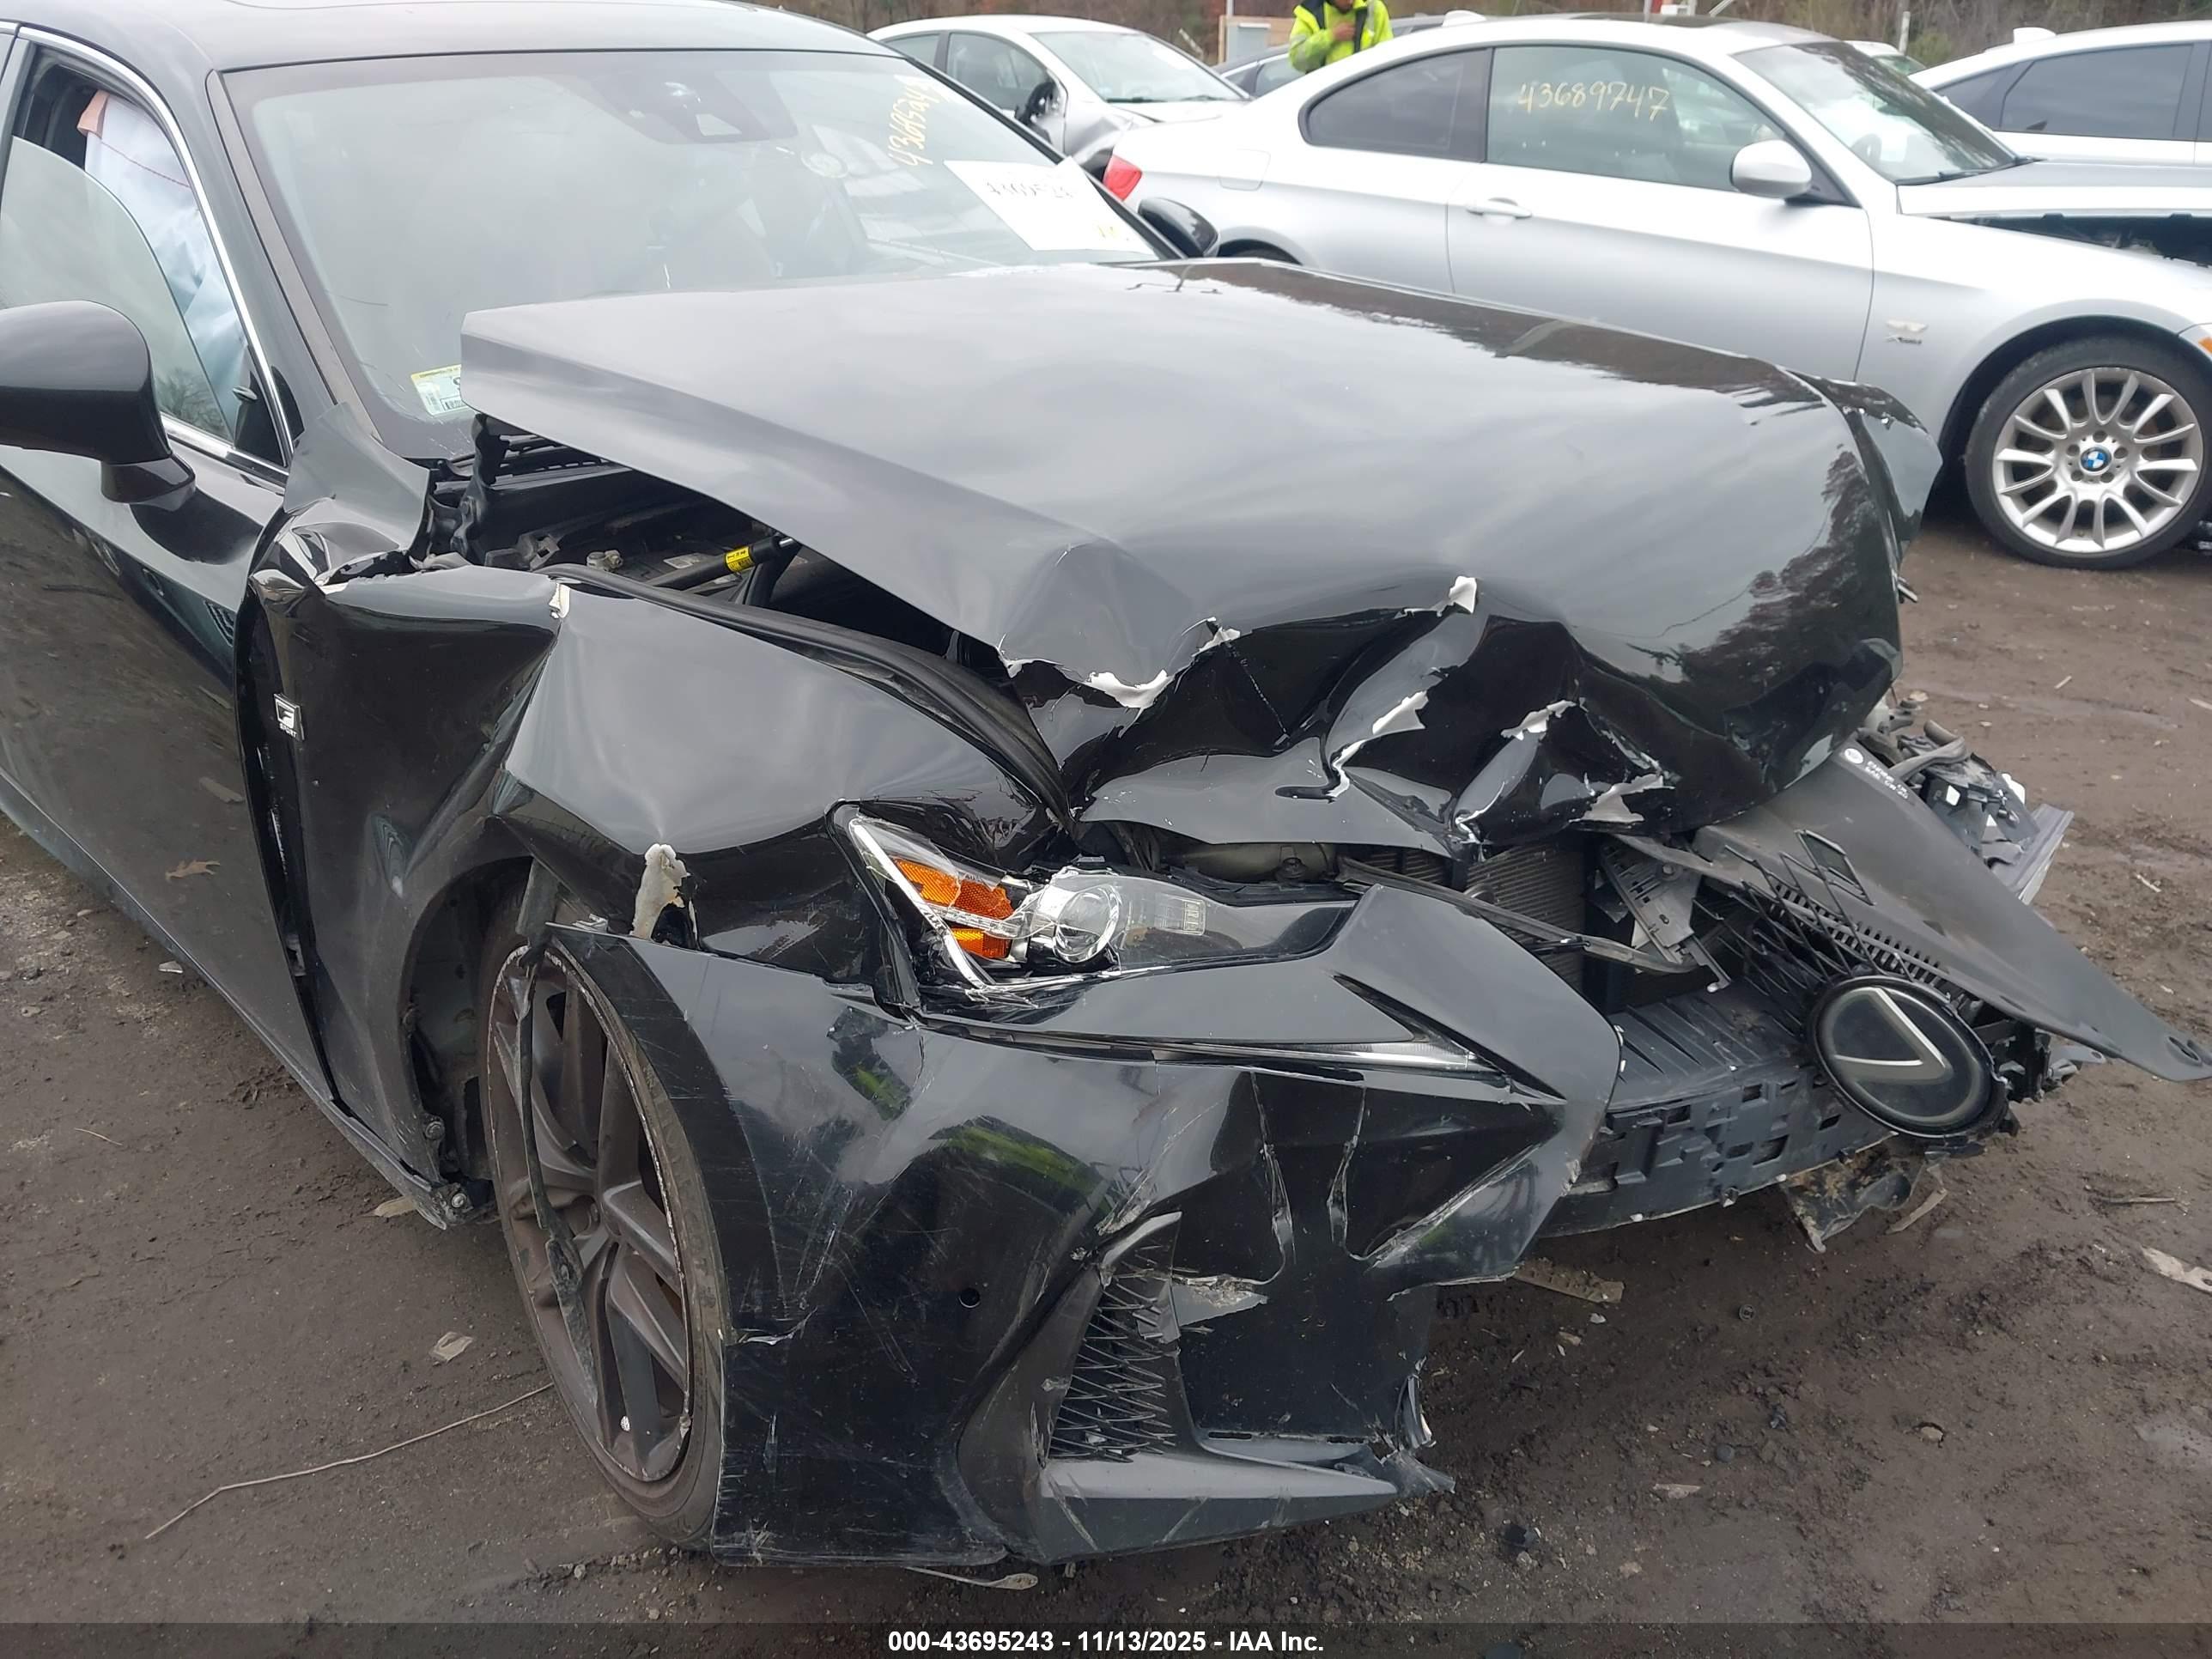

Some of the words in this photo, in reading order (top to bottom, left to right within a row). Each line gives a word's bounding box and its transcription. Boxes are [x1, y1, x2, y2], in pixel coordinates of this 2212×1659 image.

[888, 79, 945, 166] 4369524
[1517, 81, 1670, 123] 43689747
[279, 722, 297, 738] SPORT
